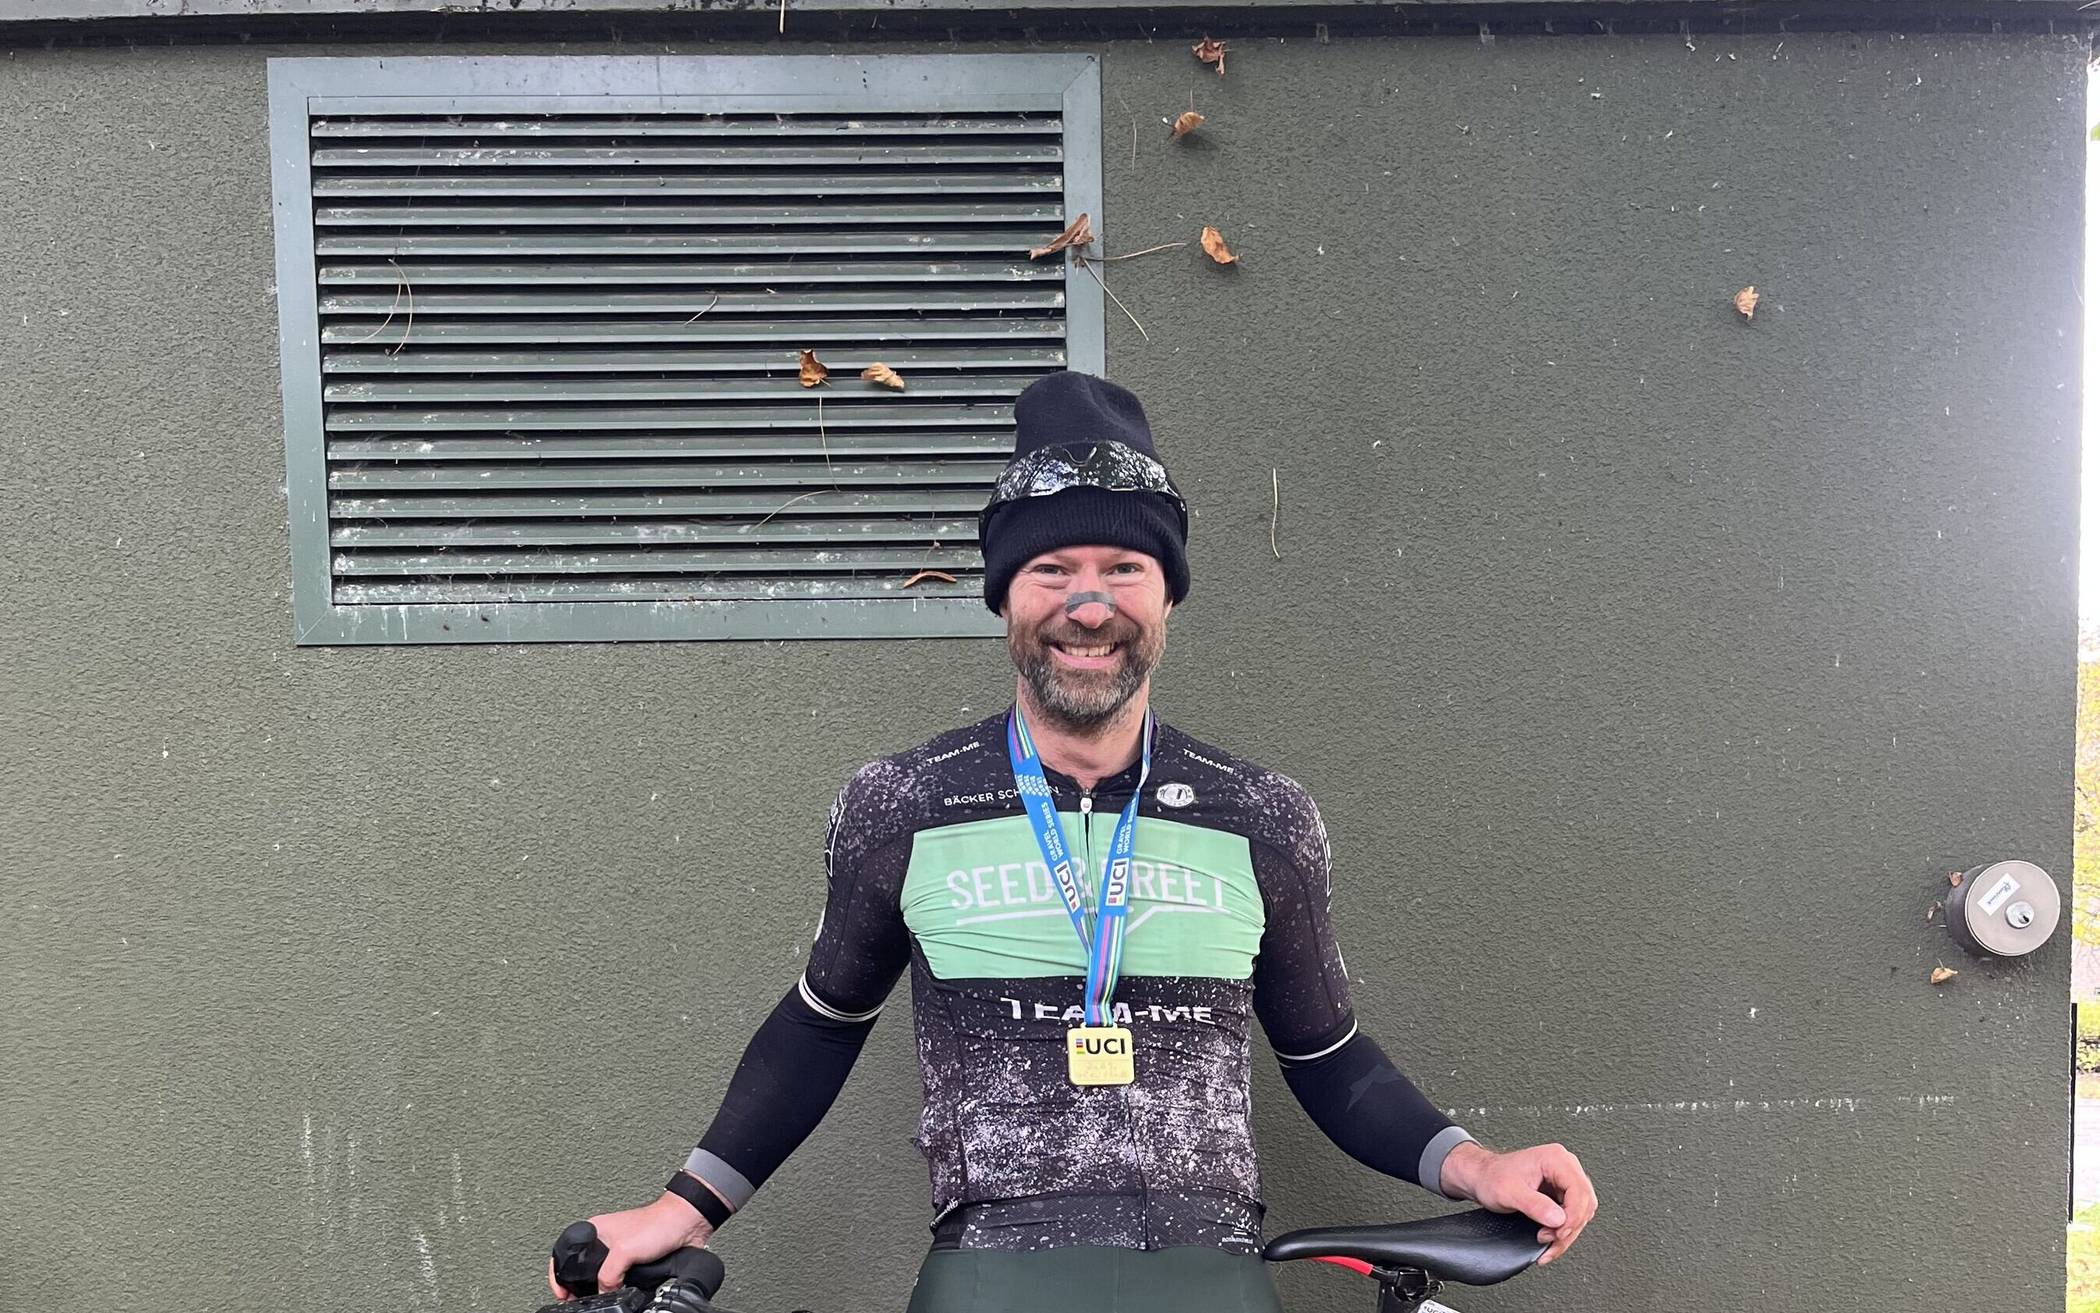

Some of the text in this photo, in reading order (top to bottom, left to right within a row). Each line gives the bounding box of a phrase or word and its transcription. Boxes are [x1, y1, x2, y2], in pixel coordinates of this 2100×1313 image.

[926, 741, 981, 765] TEAM-ME
[1183, 748, 1235, 774] TEAM-ME
[944, 785, 1060, 806] BÄCKER SCHN
[1042, 829, 1058, 862] GRAVEL
[1050, 828, 1065, 858] WORLD
[1056, 863, 1076, 902] UCI
[1101, 857, 1228, 908] REET
[1110, 860, 1127, 896] UCI
[1085, 1038, 1126, 1055] UCI
